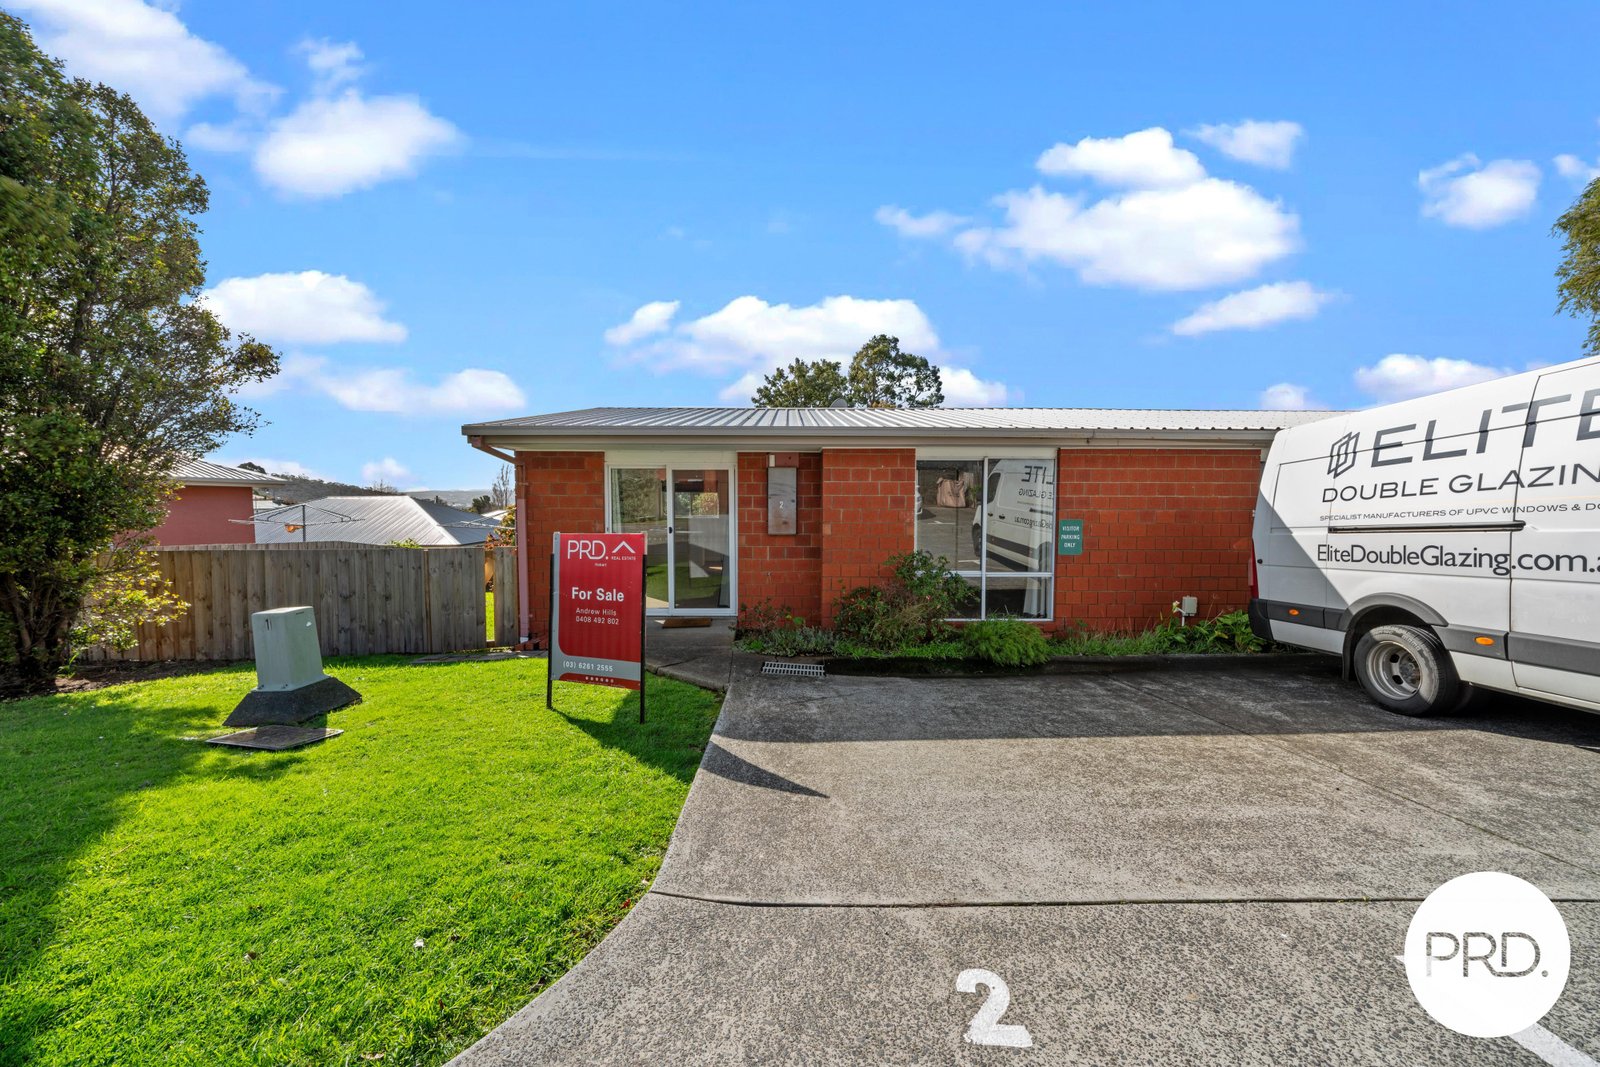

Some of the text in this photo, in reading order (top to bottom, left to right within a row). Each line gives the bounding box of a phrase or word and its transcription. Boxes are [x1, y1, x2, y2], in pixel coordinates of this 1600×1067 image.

[1371, 388, 1600, 468] ELITE
[1322, 463, 1600, 503] DOUBLE GLAZIN
[1320, 513, 1362, 521] SPECIALIST
[1363, 510, 1447, 519] MANUFACTURERS
[1449, 508, 1464, 516] OF
[1466, 507, 1499, 516] UPVC
[1502, 504, 1568, 514] WINDOWS
[1571, 503, 1582, 511] &
[571, 586, 624, 602] For Sale
[575, 607, 600, 615] Andrew
[575, 615, 620, 625] 0408 492 802
[562, 660, 613, 672] (03) 6261 2555
[956, 968, 1033, 1048] 2
